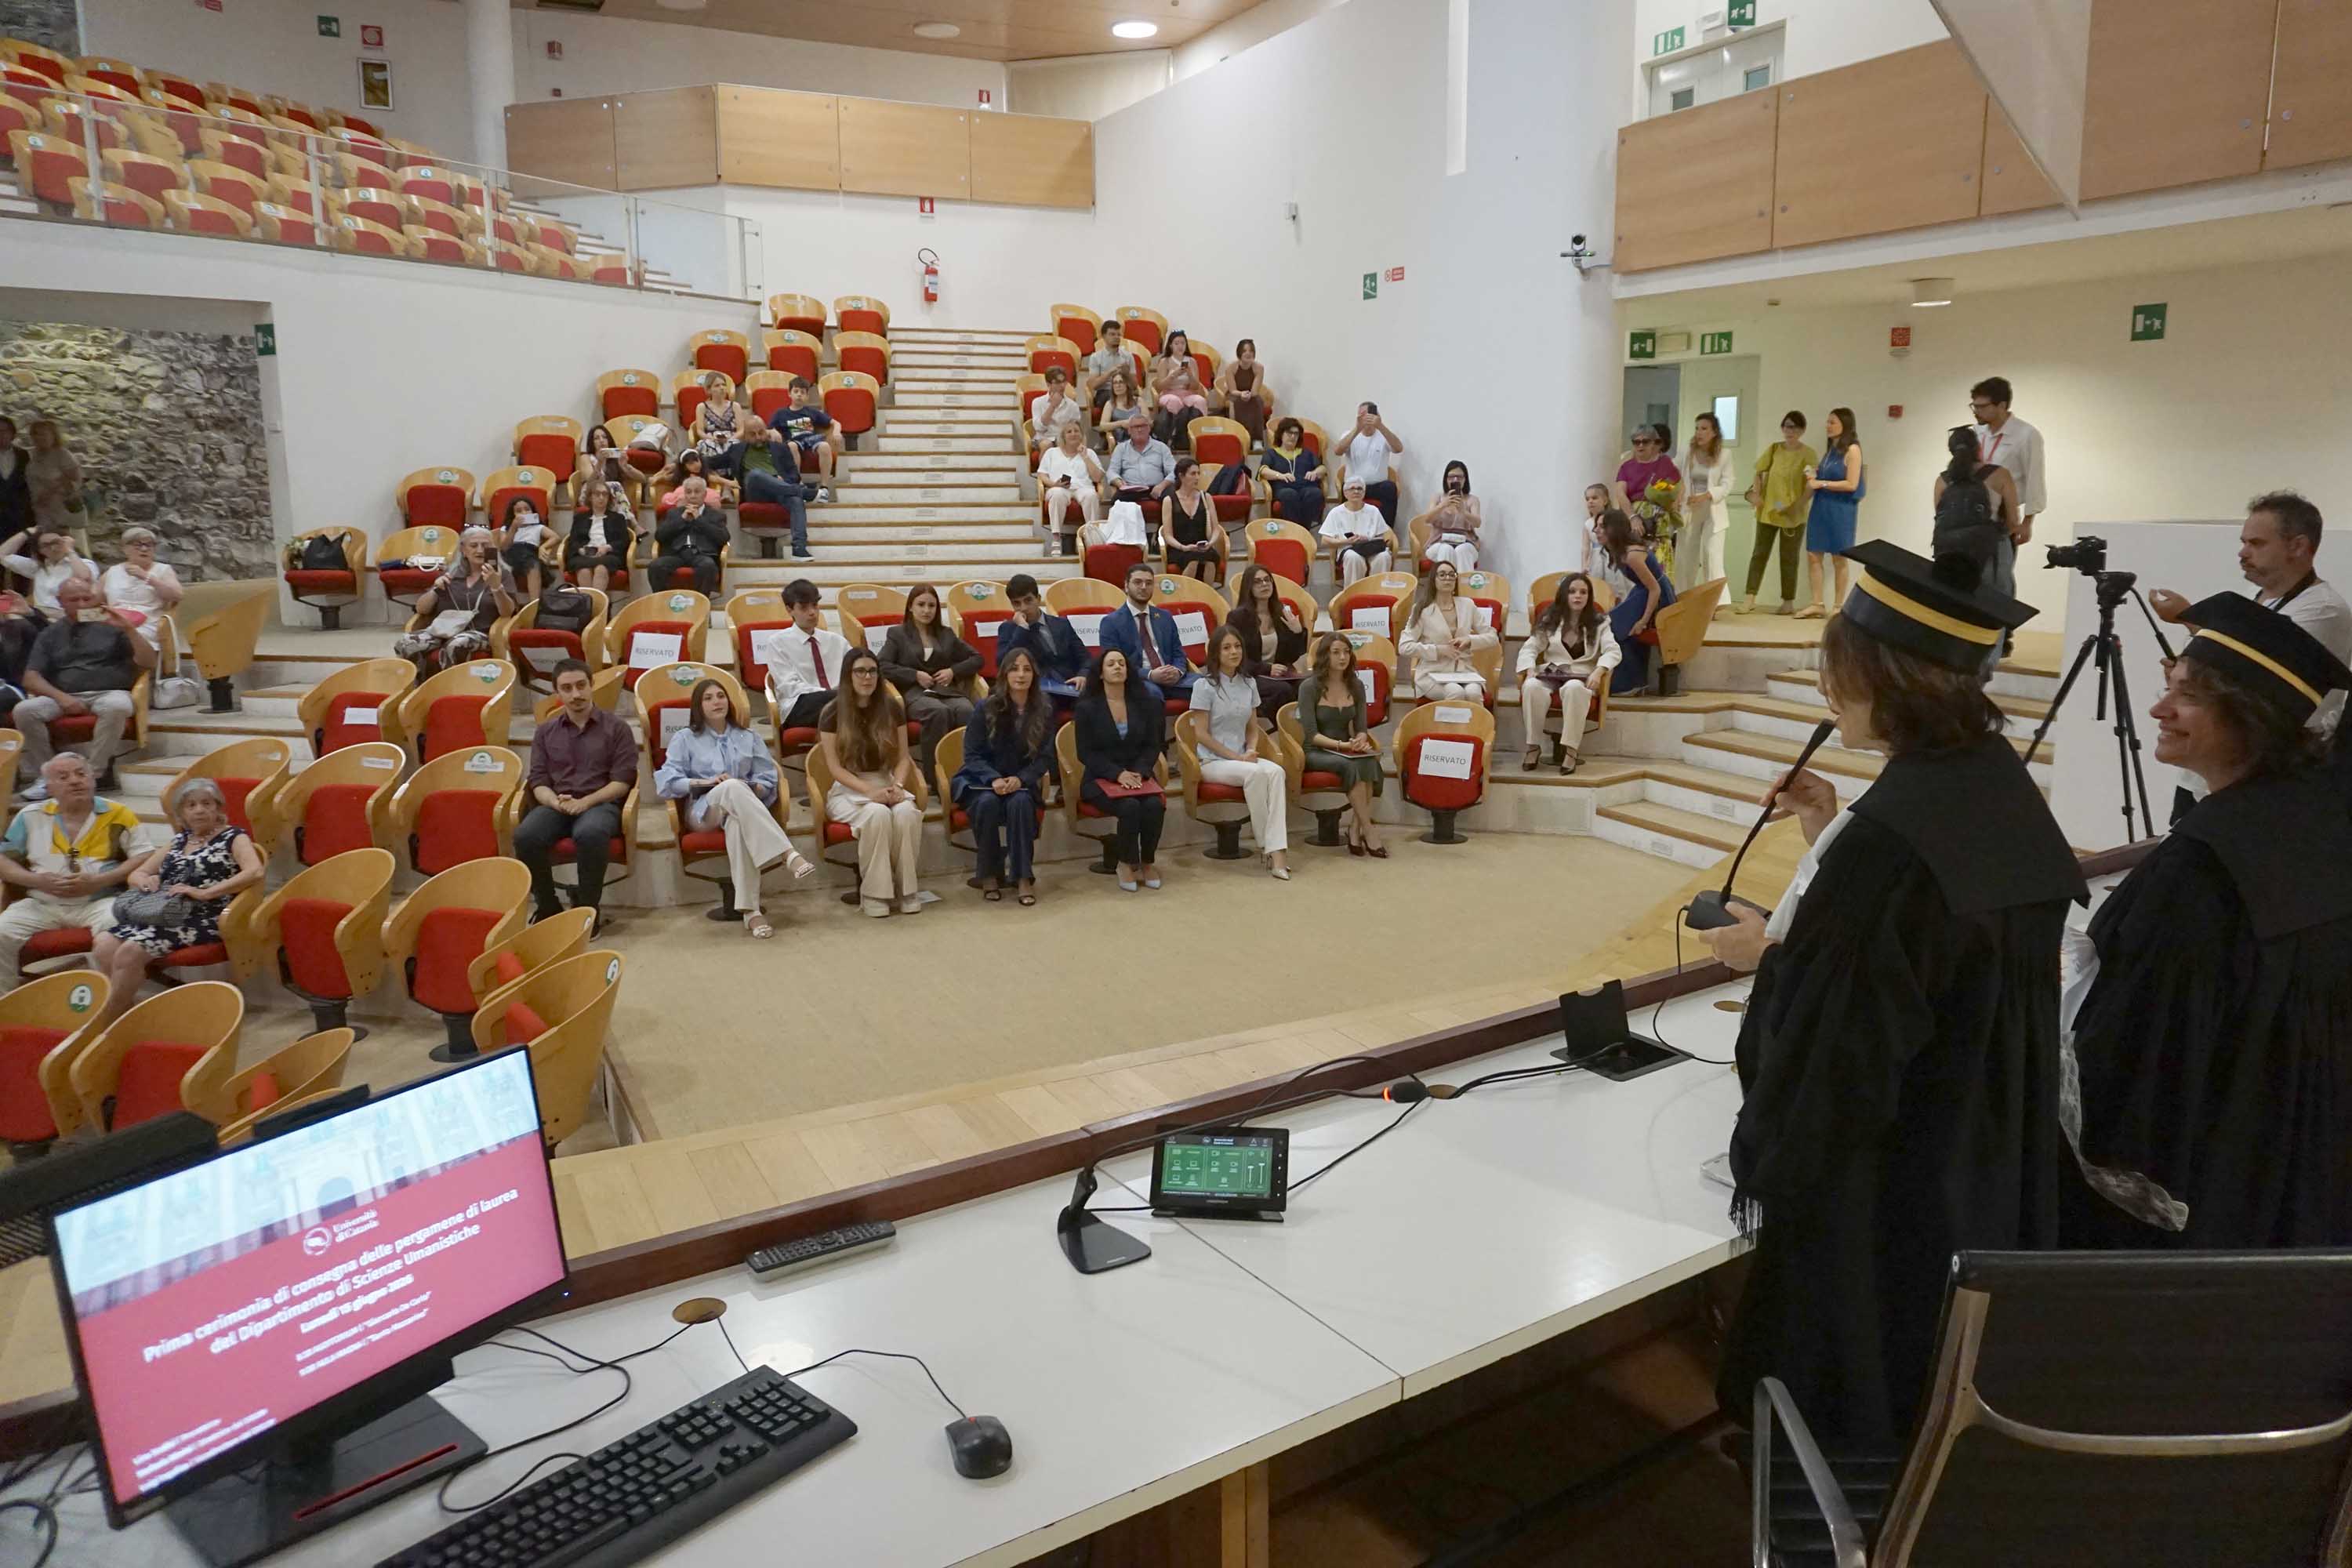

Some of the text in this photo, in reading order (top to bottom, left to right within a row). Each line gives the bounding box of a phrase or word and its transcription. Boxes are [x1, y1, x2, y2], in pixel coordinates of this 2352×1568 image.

[635, 647, 674, 658] RISERVATO
[1424, 753, 1466, 766] RISERVATO
[143, 1332, 194, 1363] Prima
[194, 1298, 274, 1340] cerimonia
[273, 1285, 290, 1305] di
[291, 1258, 359, 1297] consegna
[359, 1242, 394, 1266] delle
[394, 1213, 466, 1253] pergamene
[466, 1203, 480, 1219] di
[479, 1189, 519, 1213] laurea
[209, 1331, 238, 1354] del
[238, 1290, 336, 1341] Dipartimento
[336, 1279, 353, 1296] di
[352, 1259, 403, 1290] Scienze
[403, 1224, 481, 1265] Umanistiche
